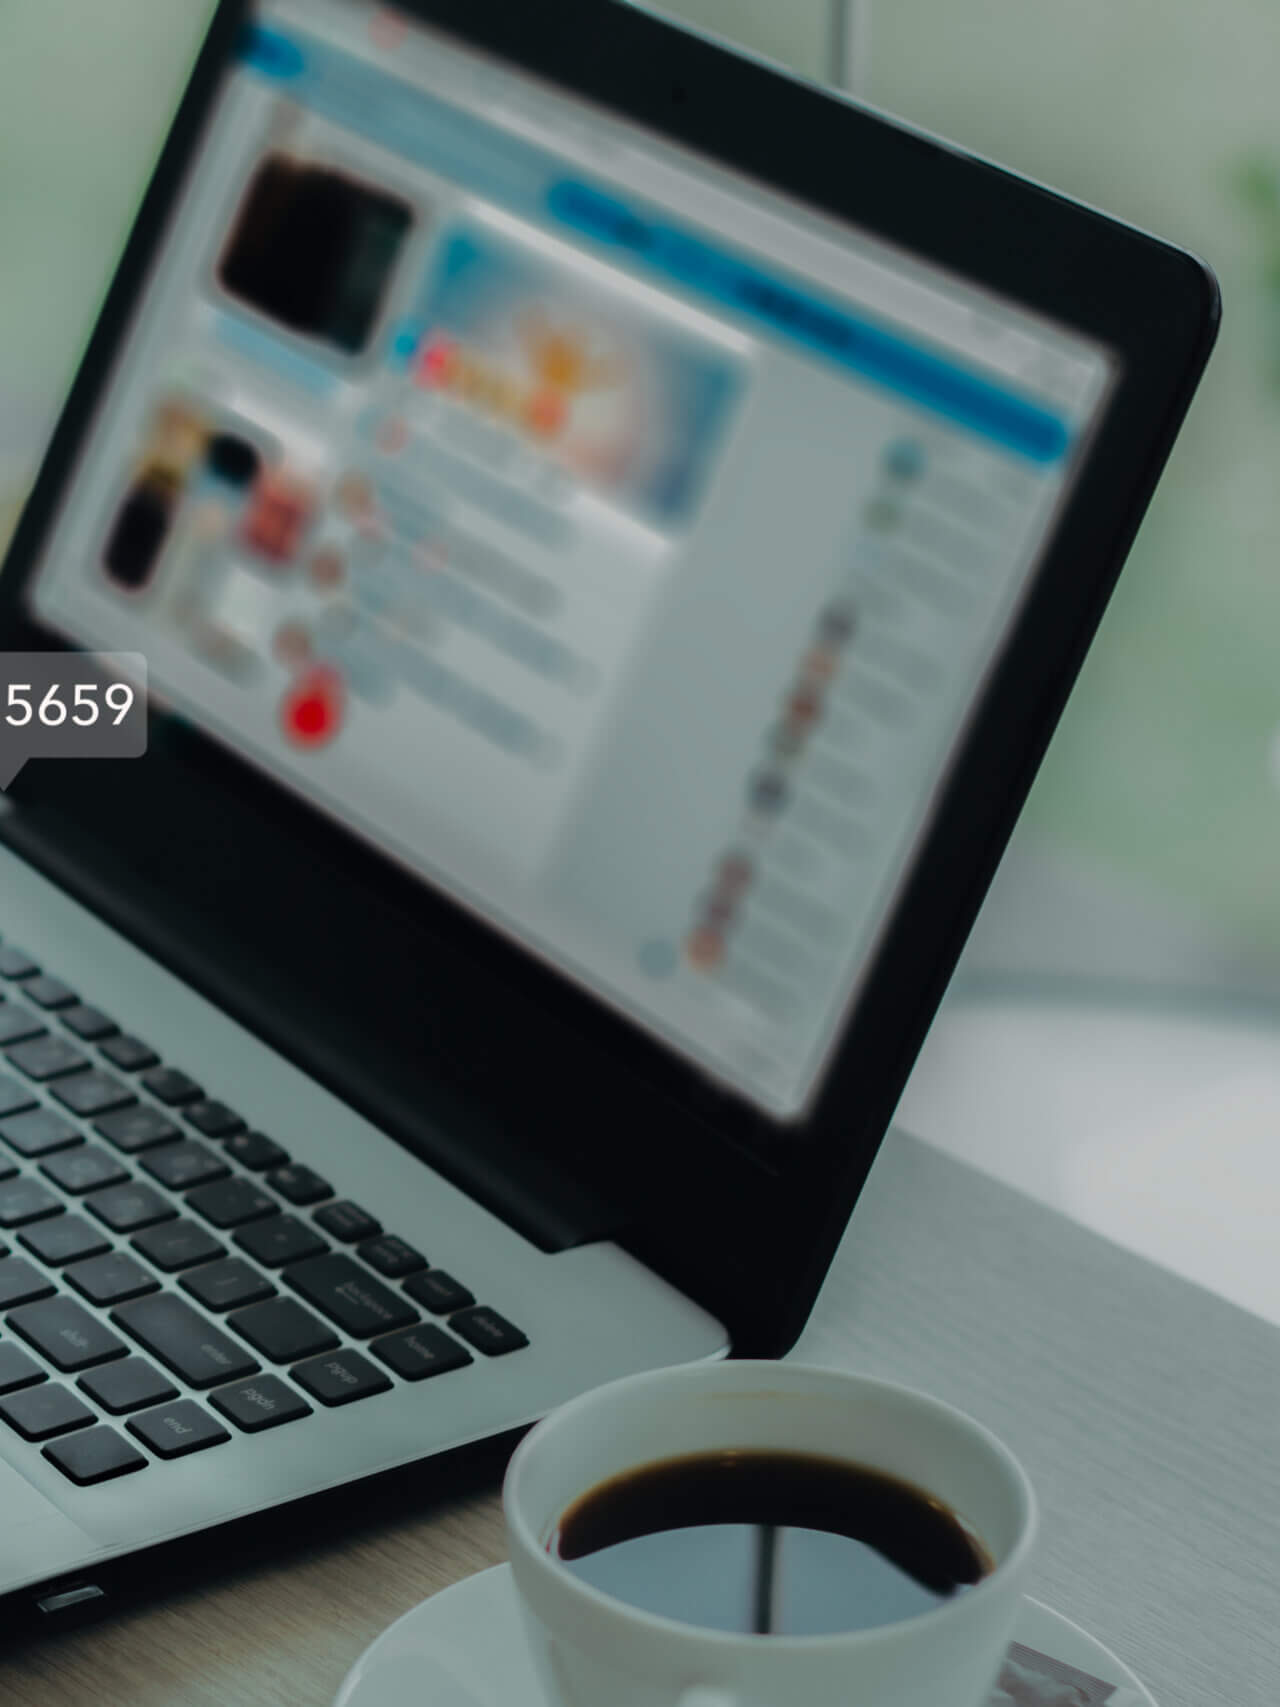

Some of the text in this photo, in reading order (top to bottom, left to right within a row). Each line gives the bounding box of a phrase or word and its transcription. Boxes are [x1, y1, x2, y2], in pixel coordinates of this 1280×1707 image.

[323, 1361, 359, 1385] pgup
[240, 1387, 277, 1411] pgdn
[163, 1416, 194, 1435] end
